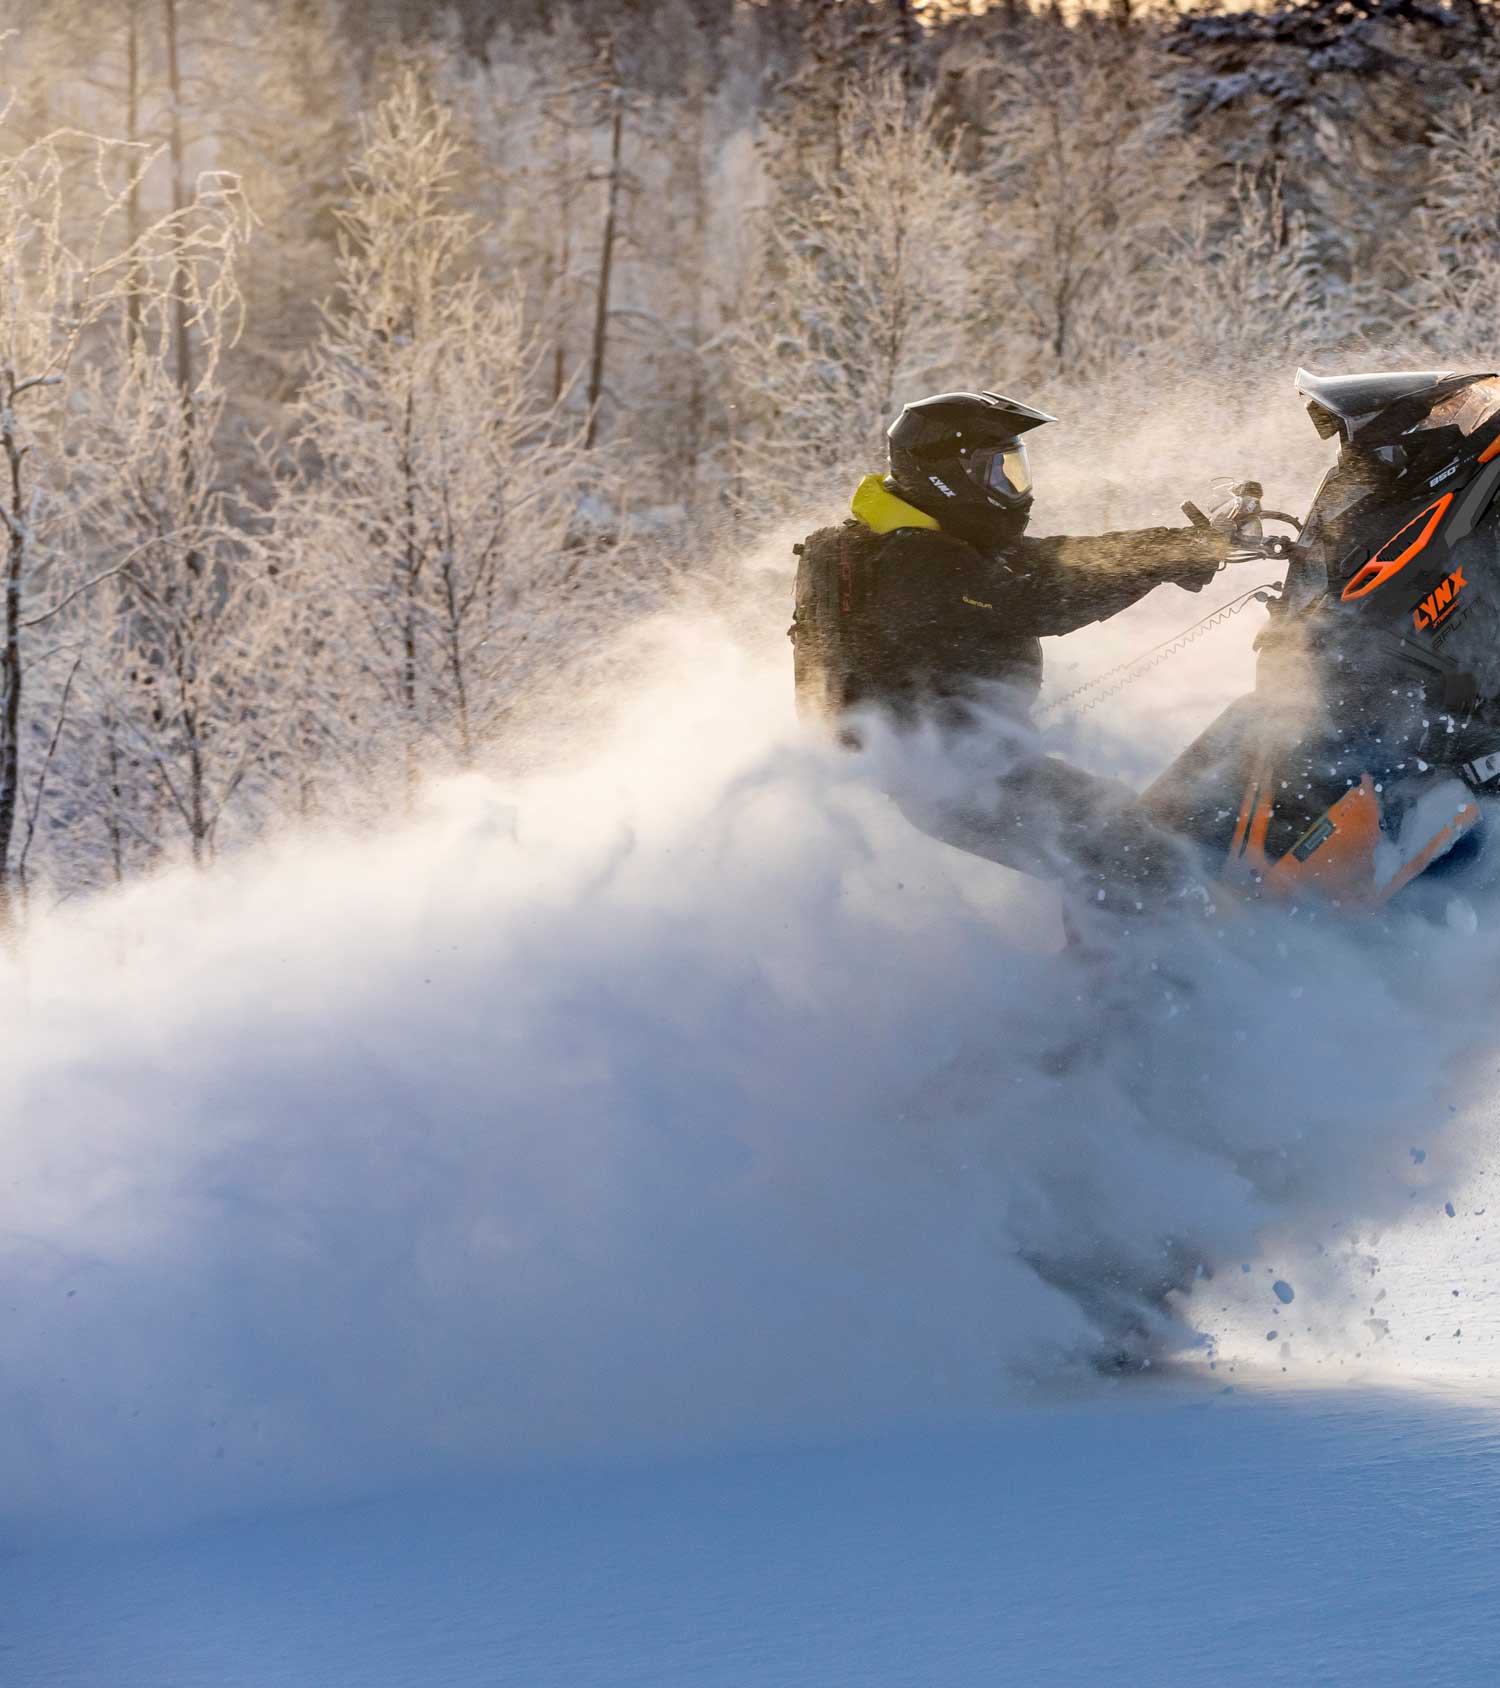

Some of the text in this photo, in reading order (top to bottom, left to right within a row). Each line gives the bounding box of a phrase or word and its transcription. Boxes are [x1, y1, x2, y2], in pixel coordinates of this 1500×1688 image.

[928, 475, 957, 498] LYNX
[1429, 466, 1457, 488] 850
[1412, 565, 1469, 633] LYNX
